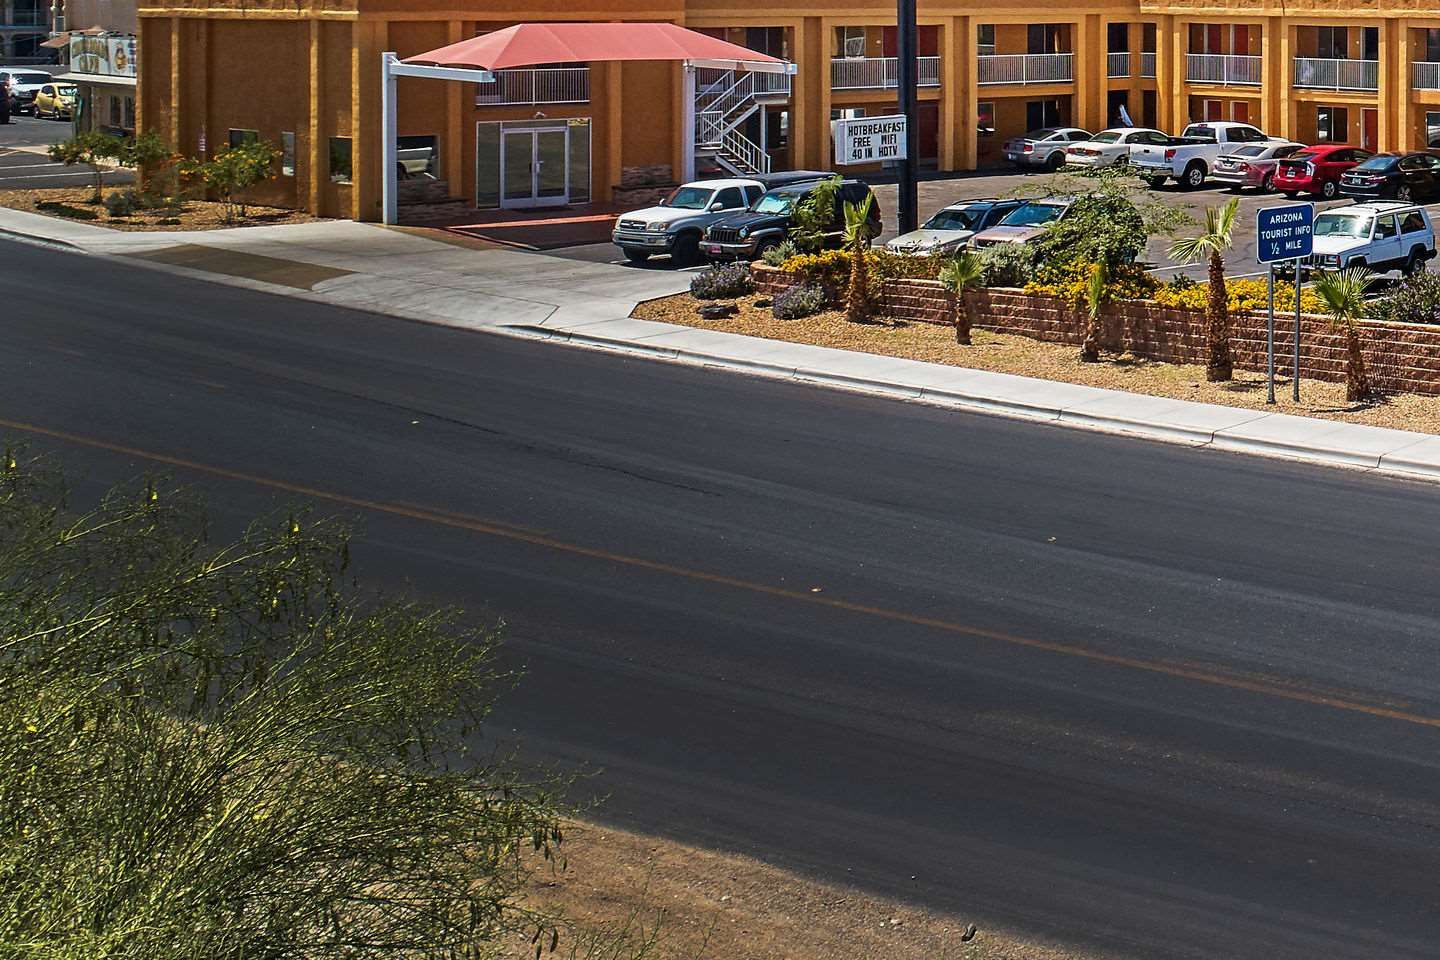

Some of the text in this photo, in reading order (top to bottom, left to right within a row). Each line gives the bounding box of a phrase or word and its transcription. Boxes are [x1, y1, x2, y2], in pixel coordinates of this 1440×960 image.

[853, 137, 871, 147] FREE
[852, 146, 898, 159] 40 IN HDTV
[1270, 212, 1303, 225] ARIZONA
[1261, 225, 1311, 240] TOURIST INFO
[1285, 240, 1302, 251] MILE
